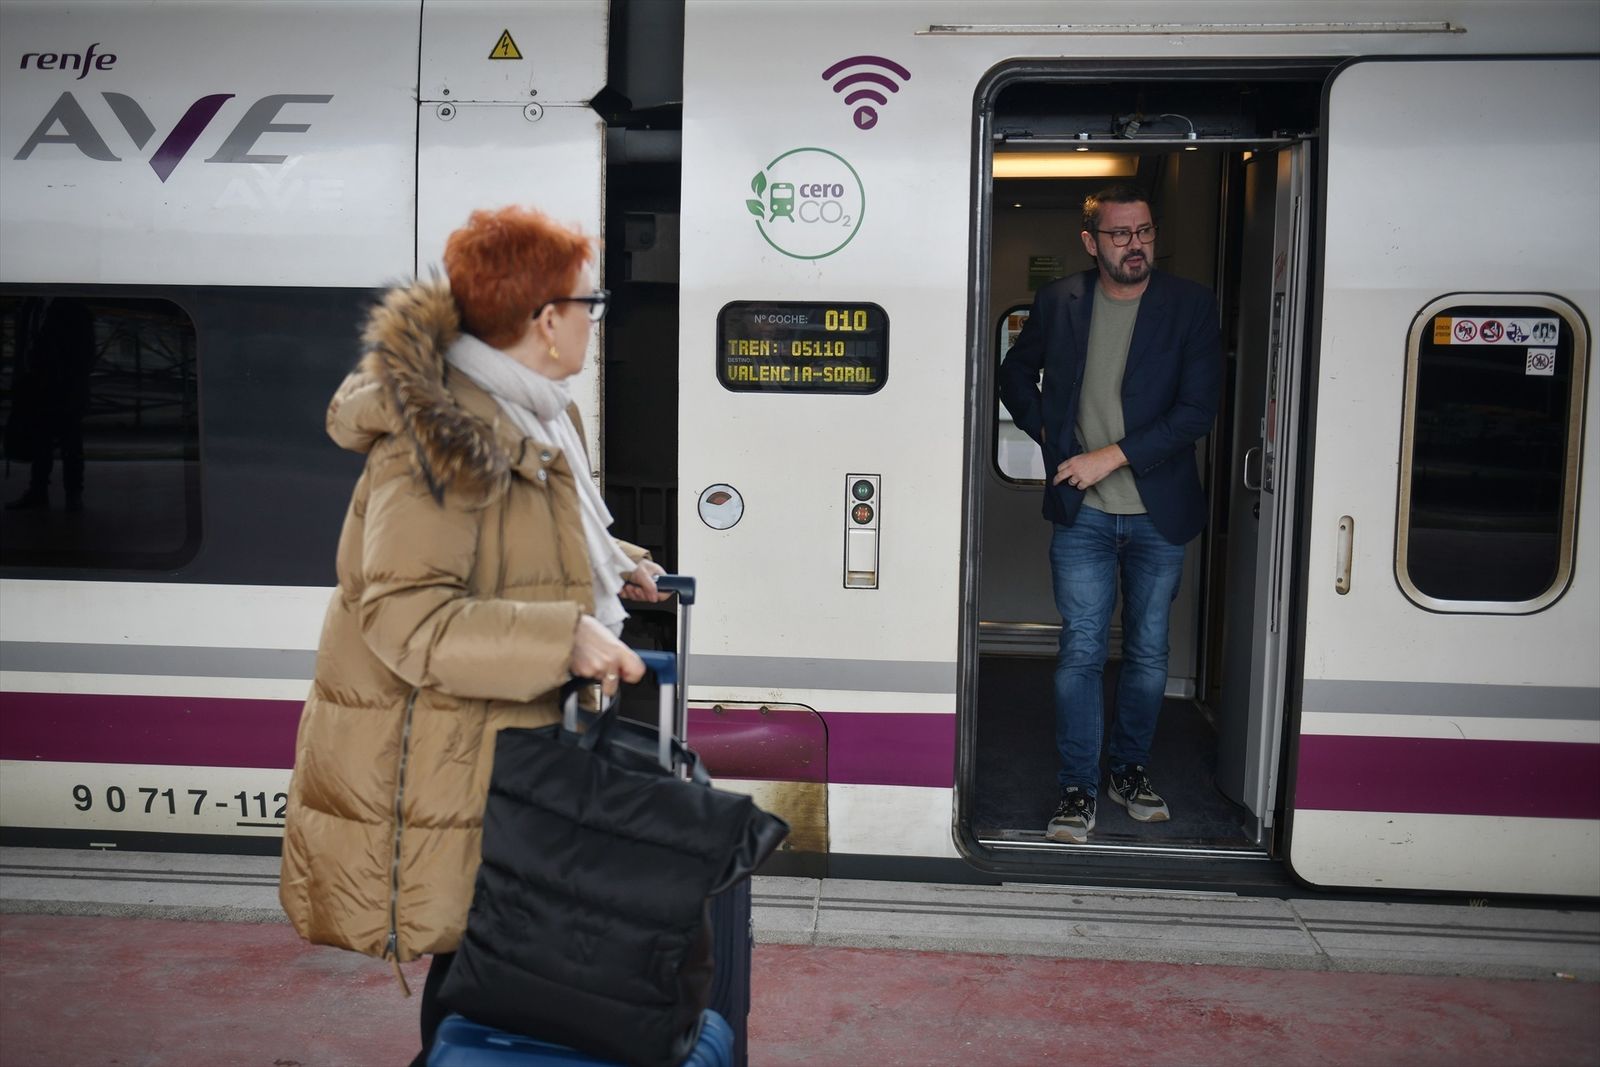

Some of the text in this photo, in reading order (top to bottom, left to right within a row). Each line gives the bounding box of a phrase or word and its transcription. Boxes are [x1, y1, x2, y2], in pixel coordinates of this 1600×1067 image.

[19, 42, 117, 80] renfe
[13, 91, 335, 183] AVE
[799, 183, 844, 198] cero
[768, 315, 809, 325] COCHE:
[825, 310, 867, 331] 010
[727, 340, 845, 357] TREN: 05110
[727, 365, 876, 383] VALENCIA-SOROL
